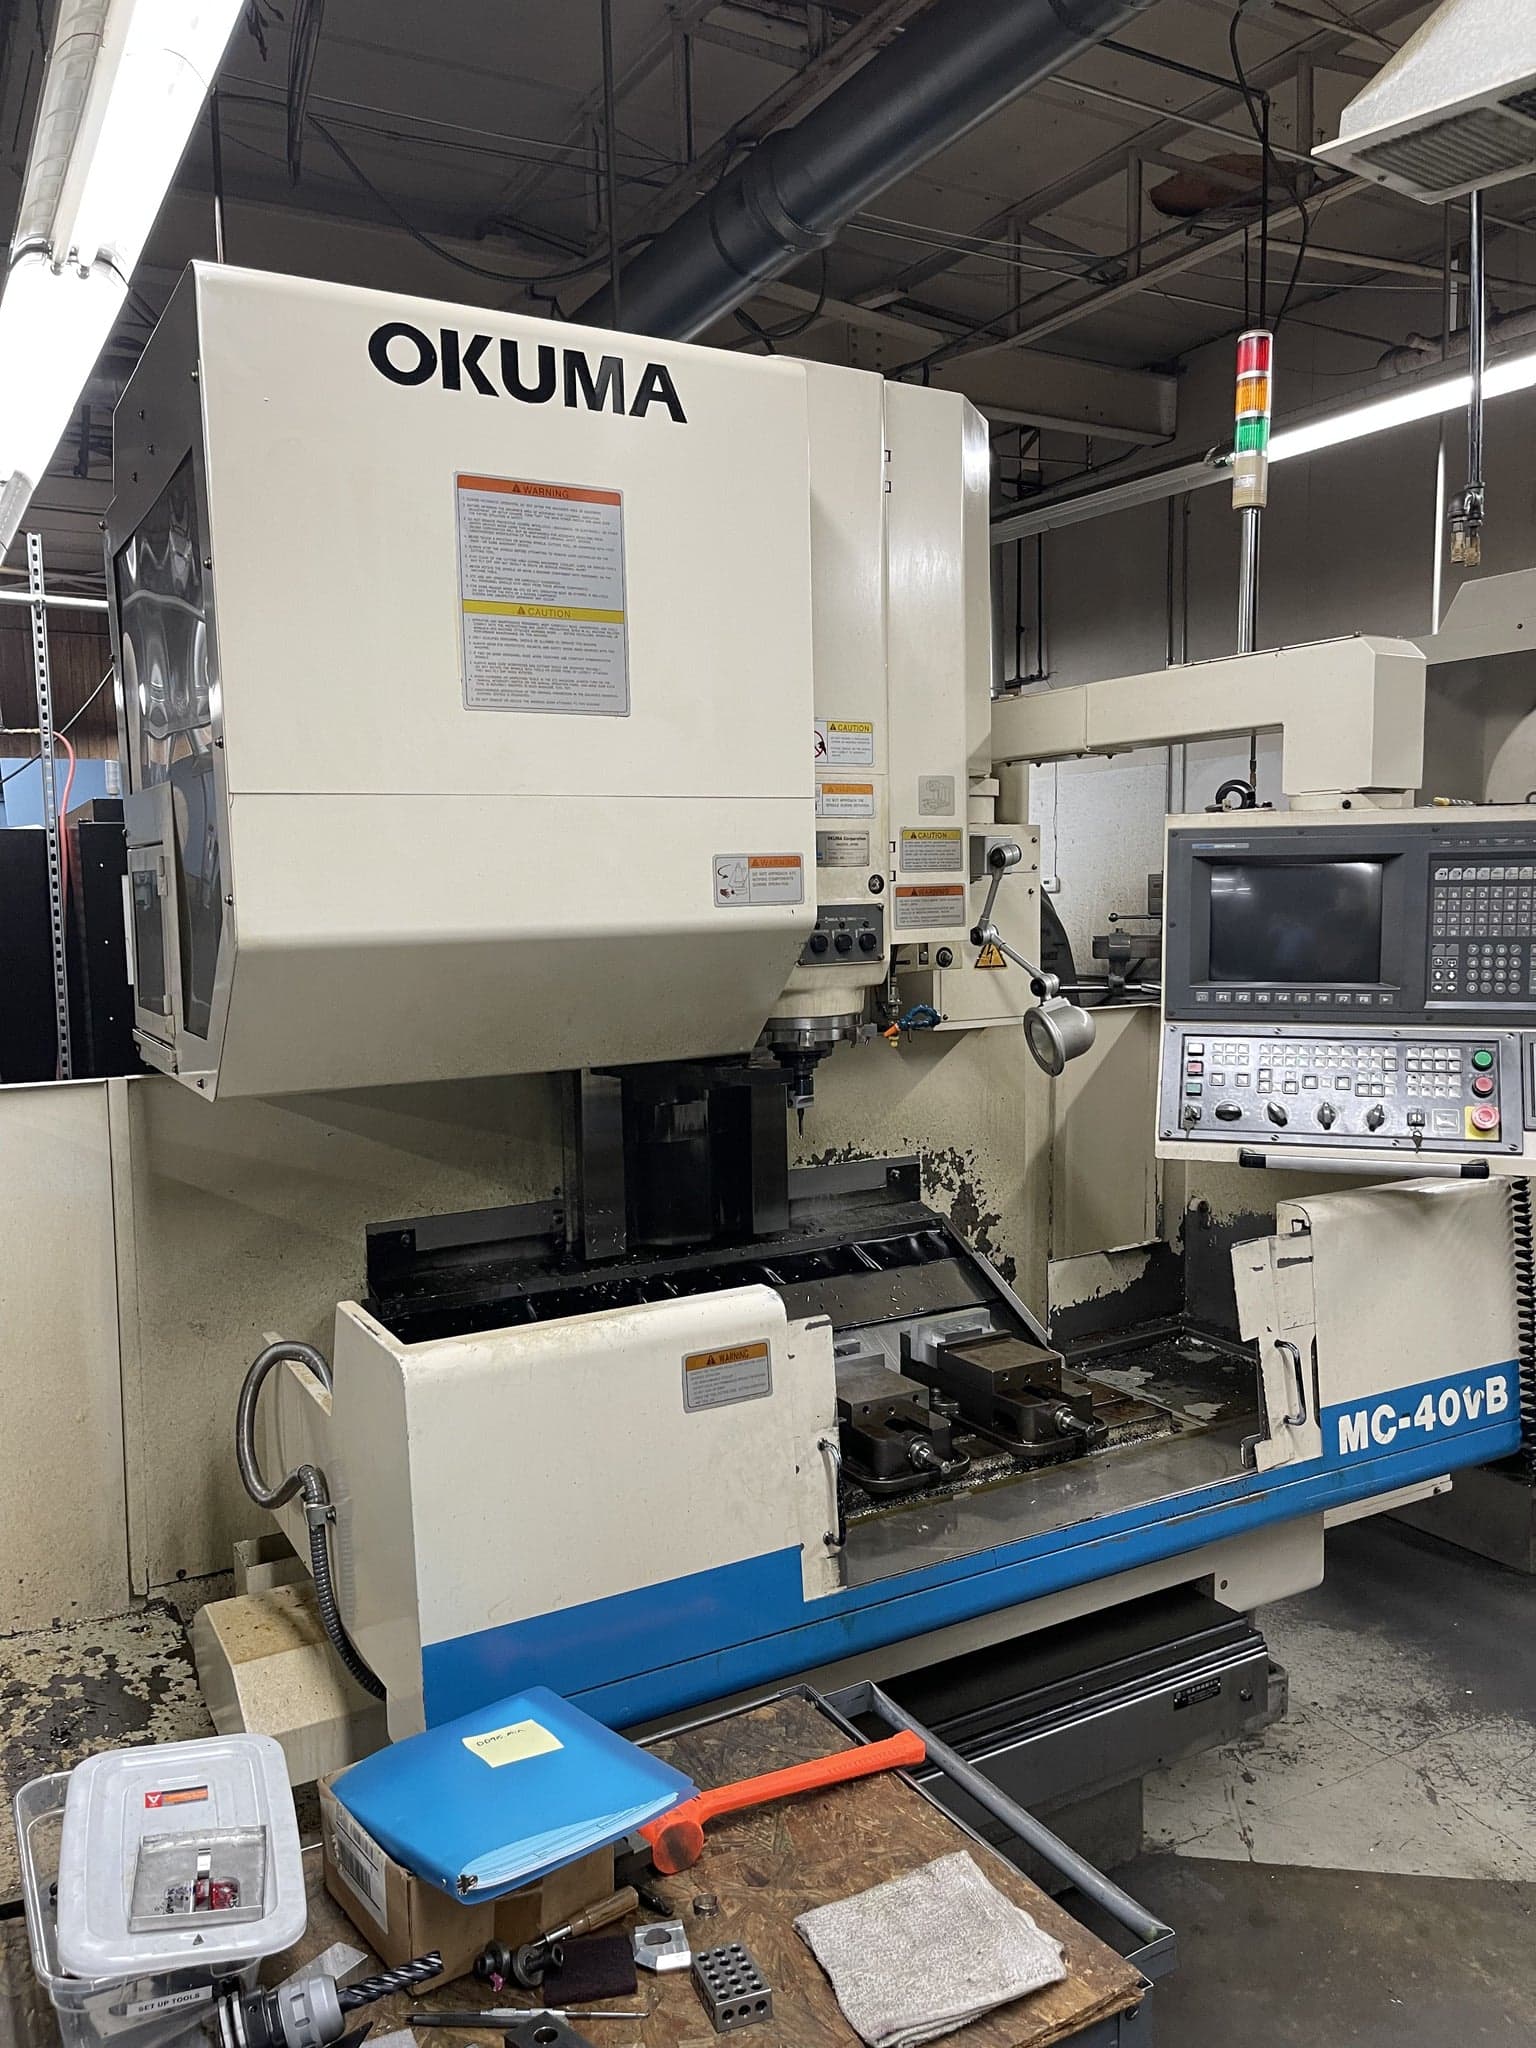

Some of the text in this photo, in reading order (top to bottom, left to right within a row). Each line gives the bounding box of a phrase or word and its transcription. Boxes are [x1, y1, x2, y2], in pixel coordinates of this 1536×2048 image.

[368, 322, 688, 424] OKUMA
[523, 486, 569, 499] WARNING
[528, 607, 571, 618] CAUTION
[720, 1348, 750, 1364] WARNING
[138, 1992, 200, 2012] SET UP TOOLS
